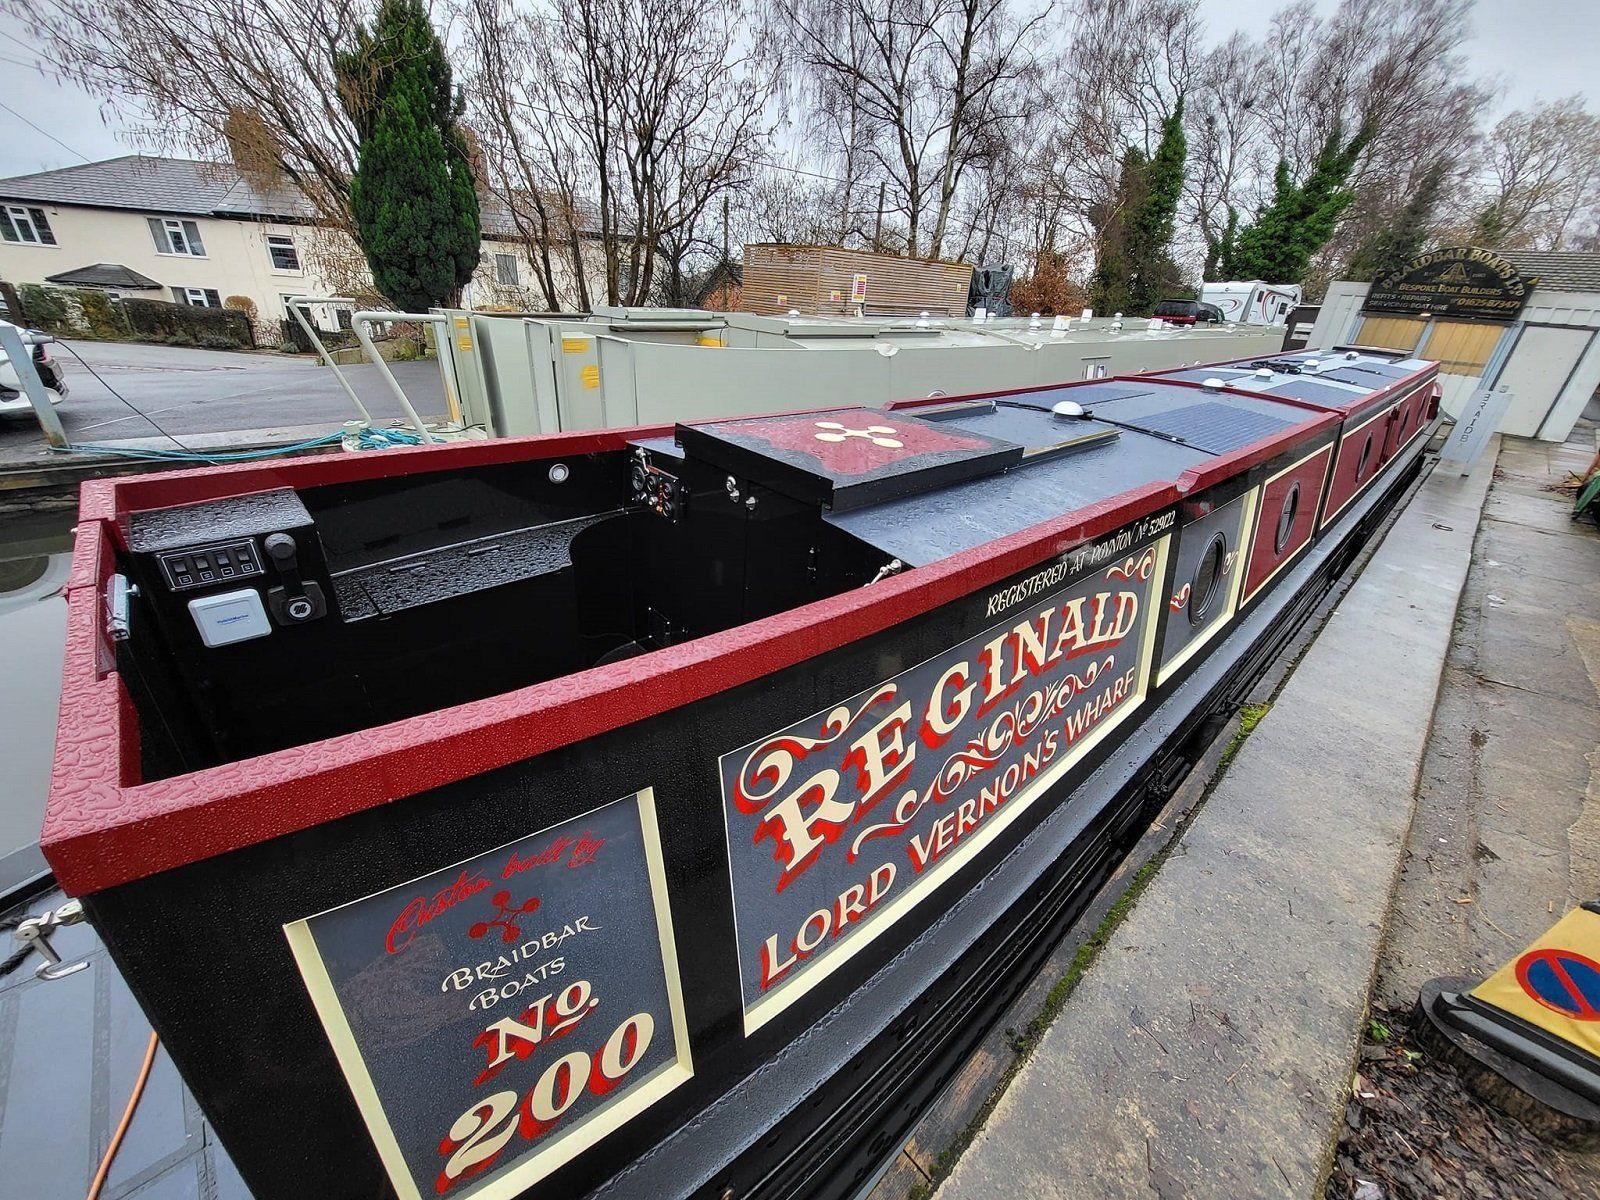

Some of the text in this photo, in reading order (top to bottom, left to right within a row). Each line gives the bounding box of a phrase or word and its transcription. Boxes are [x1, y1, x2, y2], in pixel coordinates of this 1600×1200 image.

[1398, 283, 1503, 296] BESPOKE BOAT BUILDERS
[1469, 249, 1516, 279] BOATS
[985, 562, 1068, 618] REGISTERED
[1069, 551, 1087, 576] AT
[1090, 521, 1140, 566] POYNTON
[760, 590, 1139, 876] REGINALD
[567, 829, 606, 869] by
[764, 665, 1136, 983] LORD VERNON'S WHARF
[441, 915, 604, 993] BRAIDBAR
[468, 956, 566, 1012] BOATS
[442, 1011, 656, 1183] 200
